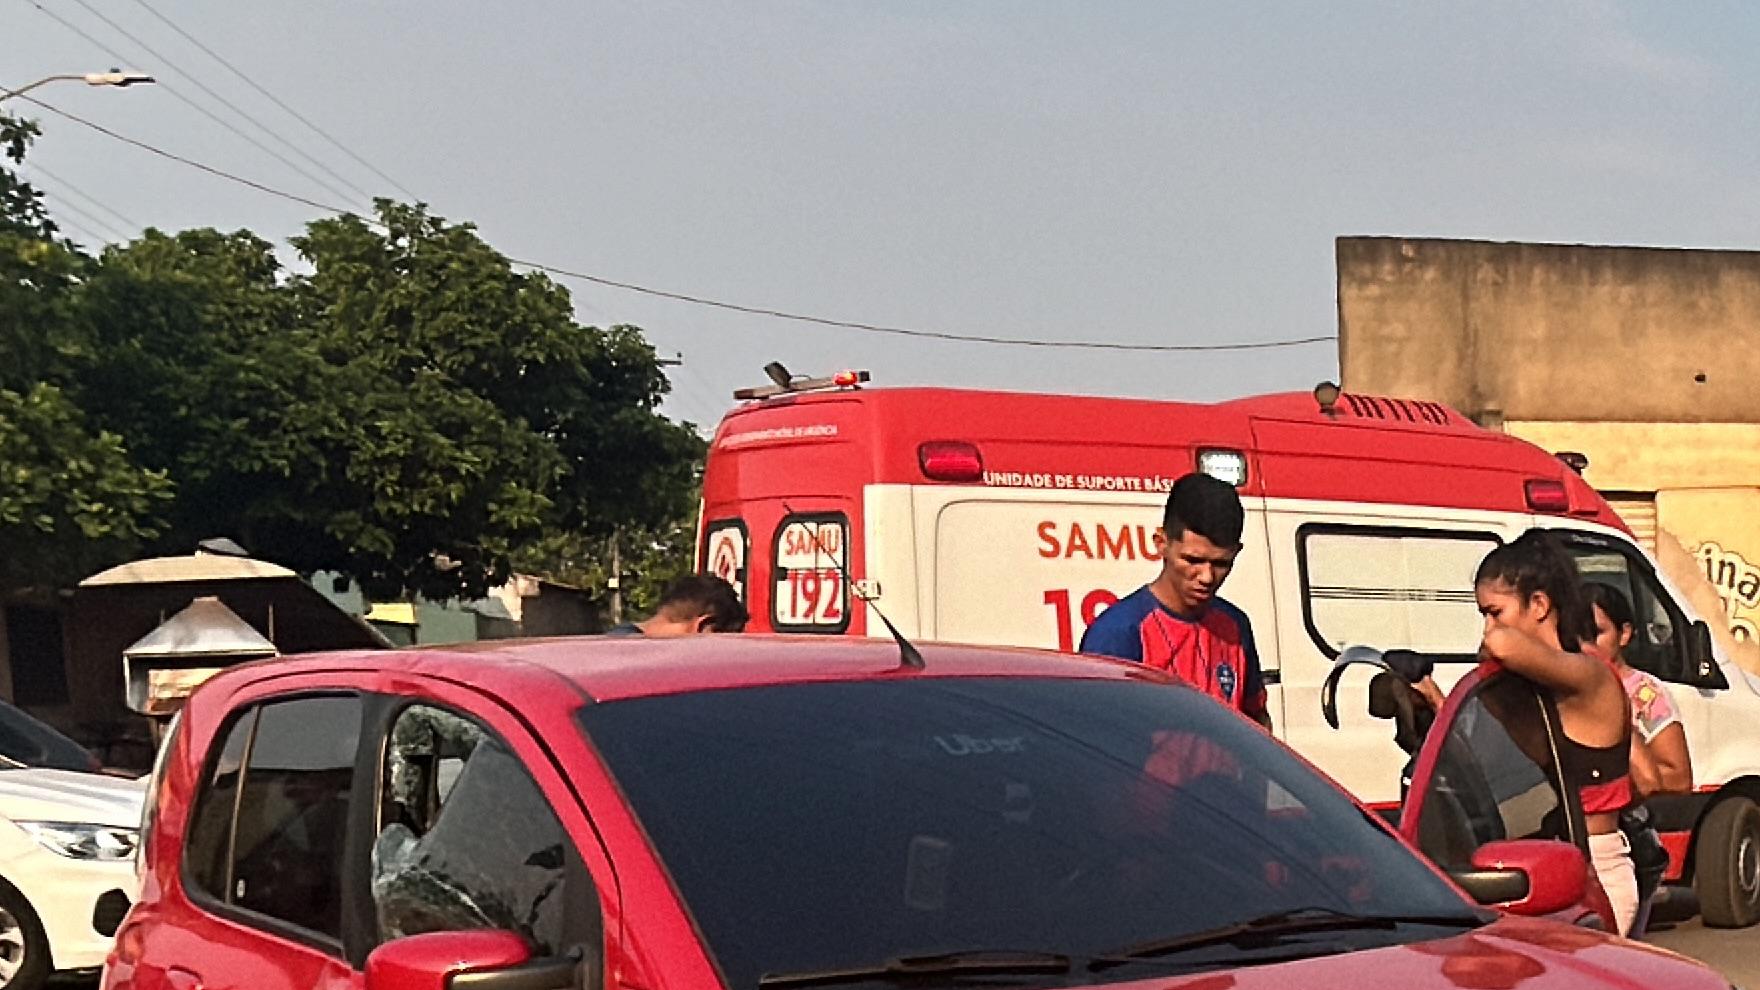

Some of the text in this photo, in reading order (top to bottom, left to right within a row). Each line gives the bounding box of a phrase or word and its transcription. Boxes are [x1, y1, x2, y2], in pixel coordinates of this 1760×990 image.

[982, 471, 1053, 487] UNIDADE
[1055, 474, 1074, 488] DE
[1076, 475, 1141, 490] SUPORTE
[785, 528, 840, 556] SAMU
[1036, 520, 1165, 562] SAMU
[786, 569, 840, 618] 192
